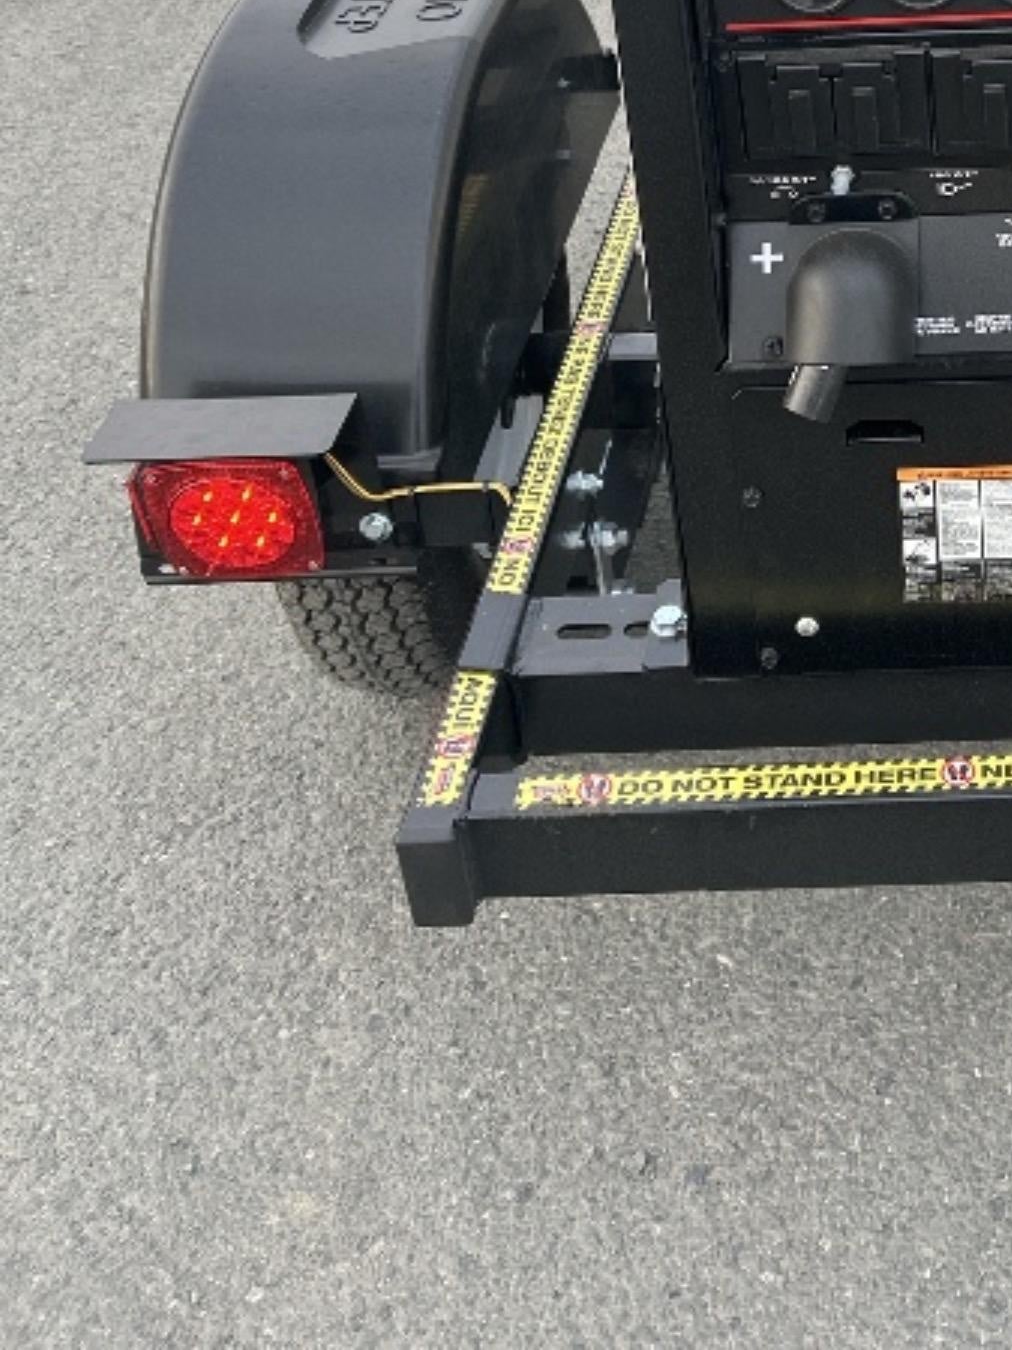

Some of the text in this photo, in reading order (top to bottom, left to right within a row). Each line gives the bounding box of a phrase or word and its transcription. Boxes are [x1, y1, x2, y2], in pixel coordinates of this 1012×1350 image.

[617, 766, 938, 796] DO NOT STAND HERE
